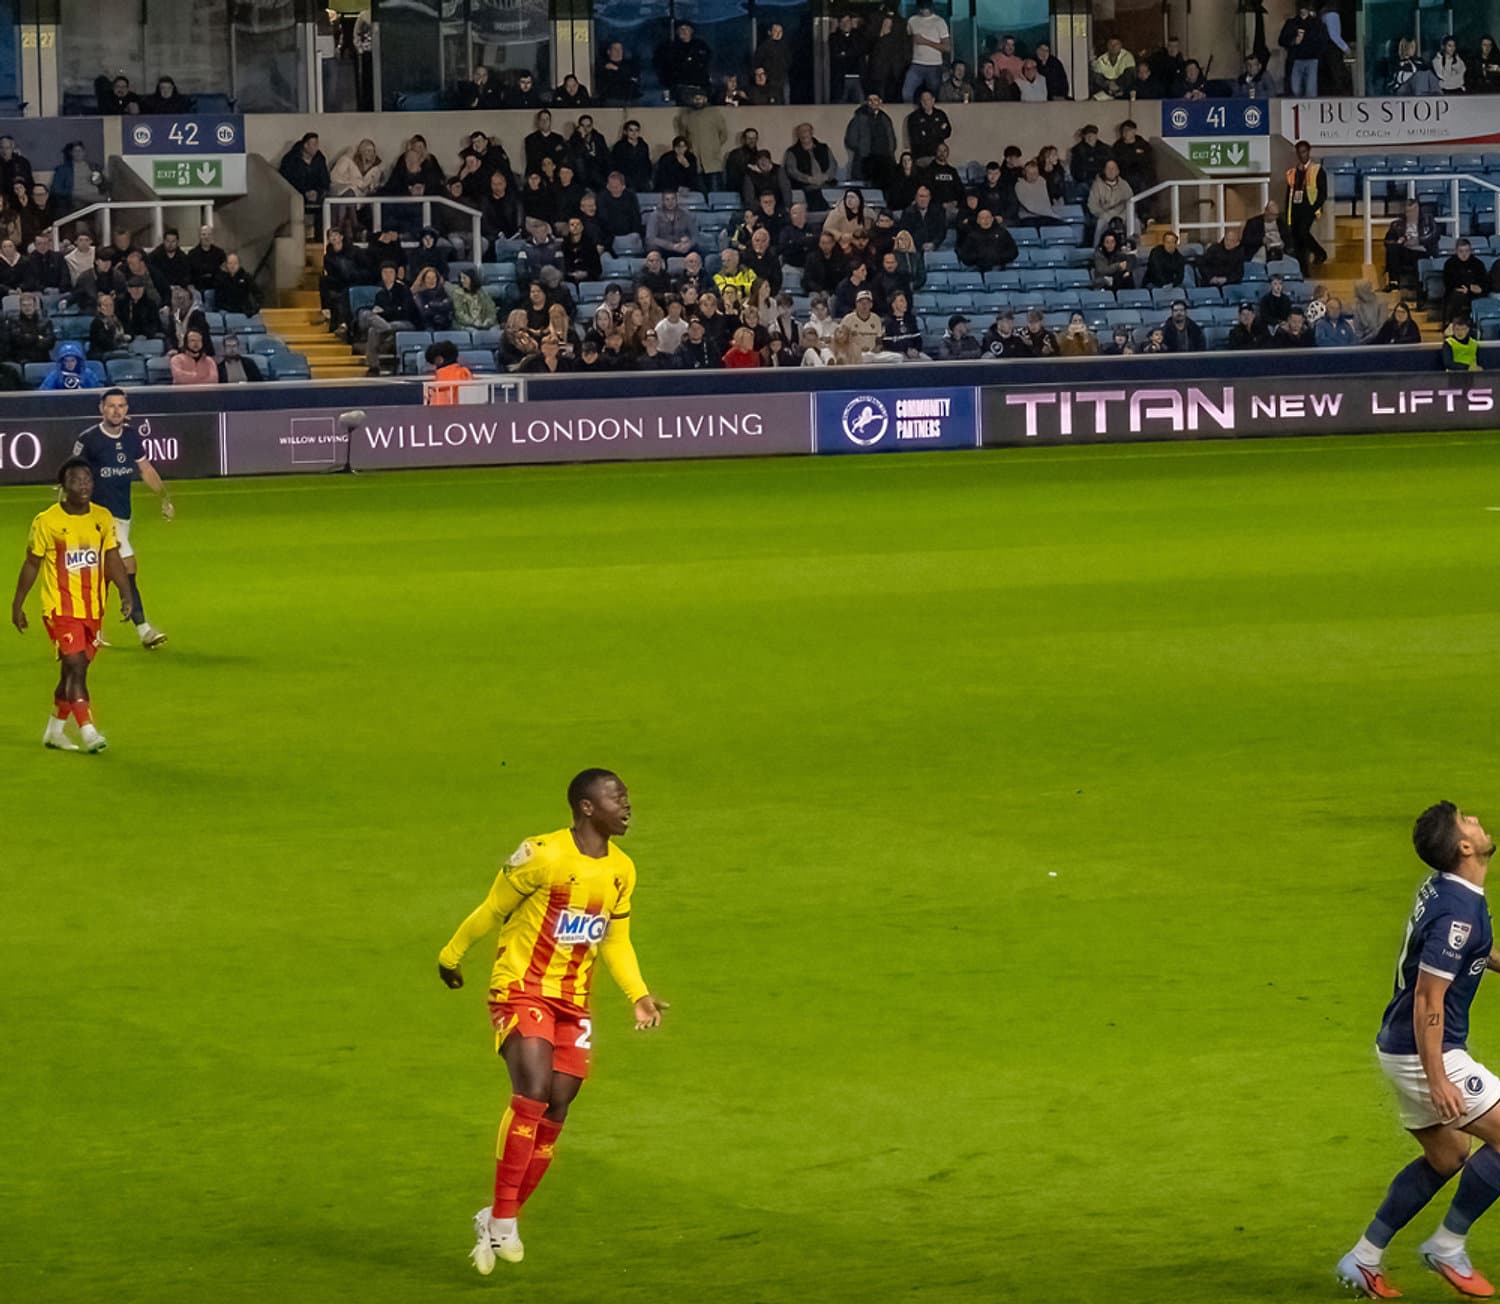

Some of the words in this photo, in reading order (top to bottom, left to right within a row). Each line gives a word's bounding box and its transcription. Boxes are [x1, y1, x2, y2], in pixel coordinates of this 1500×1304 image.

[1206, 106, 1226, 128] 41
[1320, 102, 1370, 124] BUS
[1380, 100, 1449, 123] STOP
[168, 122, 200, 145] 42
[896, 398, 951, 419] COMMUNITY
[1006, 386, 1235, 436] TITAN
[1251, 393, 1344, 419] NEW
[1372, 388, 1494, 415] LIFTS
[279, 435, 316, 445] WILLOW
[318, 434, 349, 444] LIVING
[365, 422, 498, 449] WILLOW
[511, 417, 643, 444] LONDON
[658, 413, 763, 438] LIVING
[896, 419, 941, 439] PARTNERS
[67, 550, 98, 566] MrQ
[558, 913, 606, 940] MrQ
